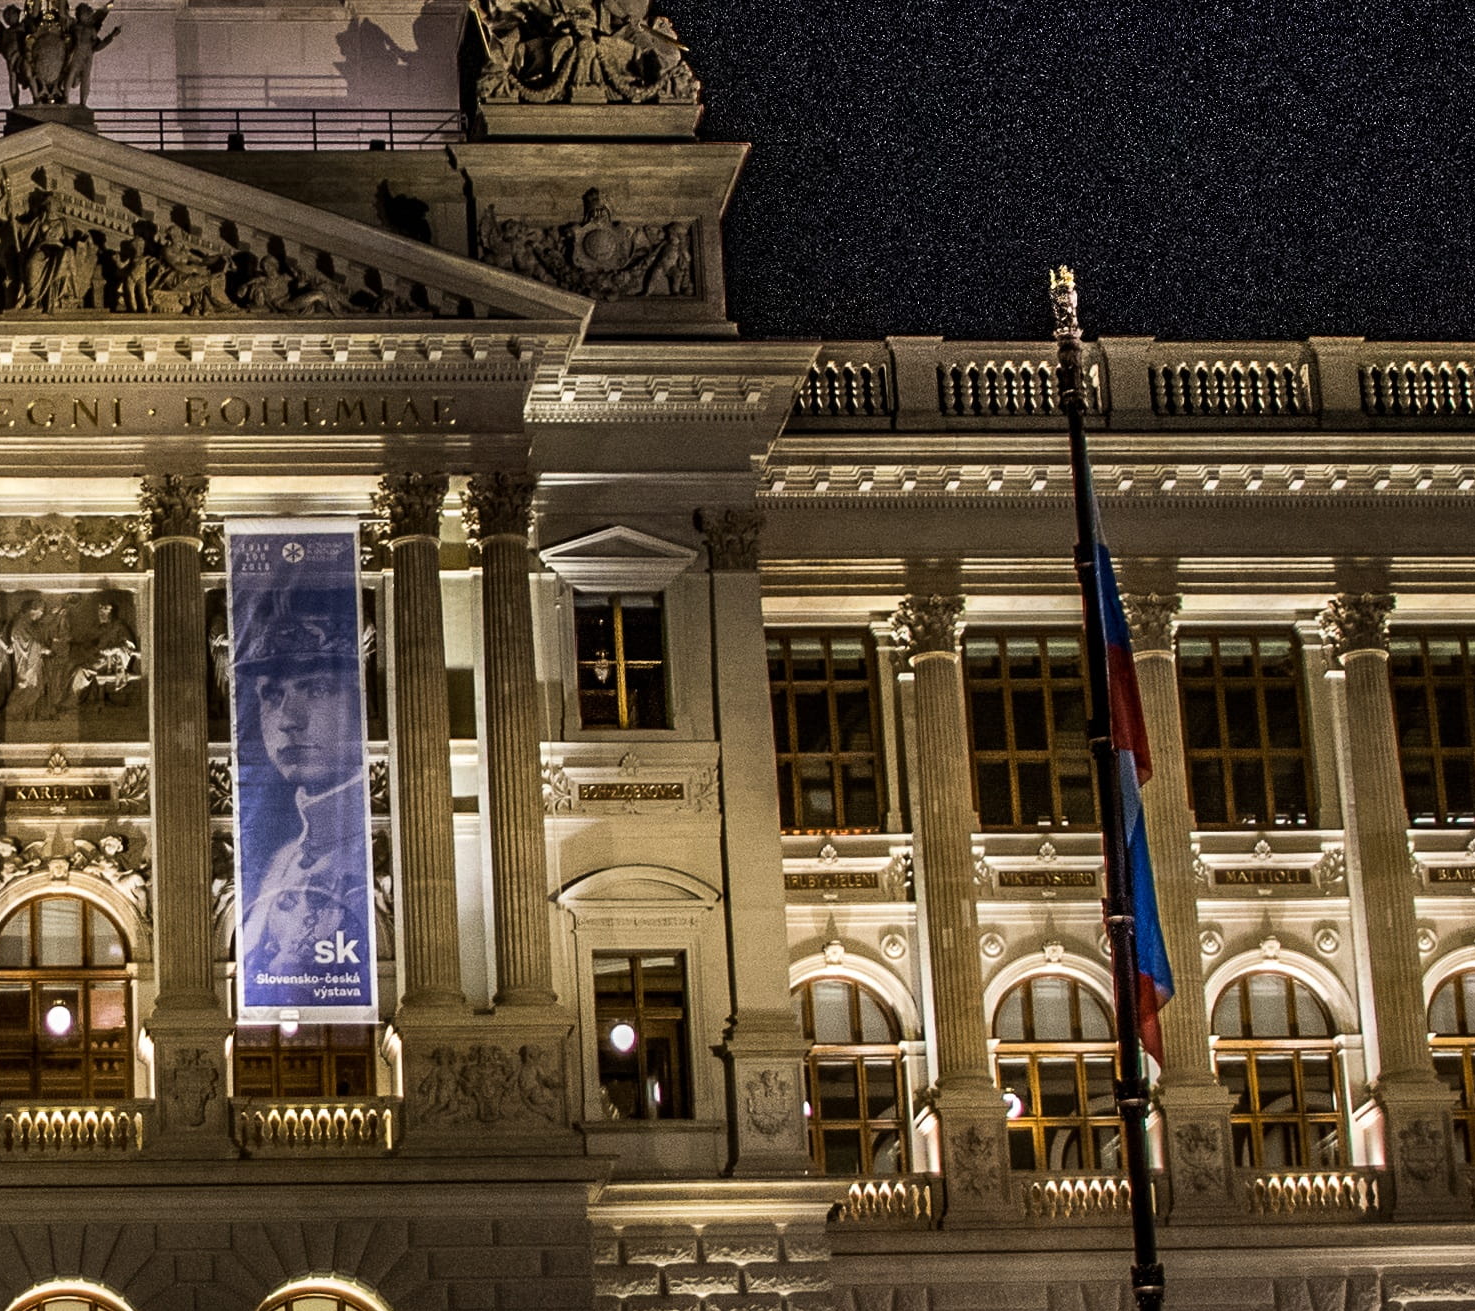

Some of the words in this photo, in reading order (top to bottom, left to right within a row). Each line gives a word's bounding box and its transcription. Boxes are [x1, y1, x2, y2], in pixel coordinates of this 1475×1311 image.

[184, 395, 457, 427] BOHEMIAE
[313, 929, 362, 965] sk
[255, 971, 362, 985] Slovensko-česká
[313, 986, 362, 999] výstava
